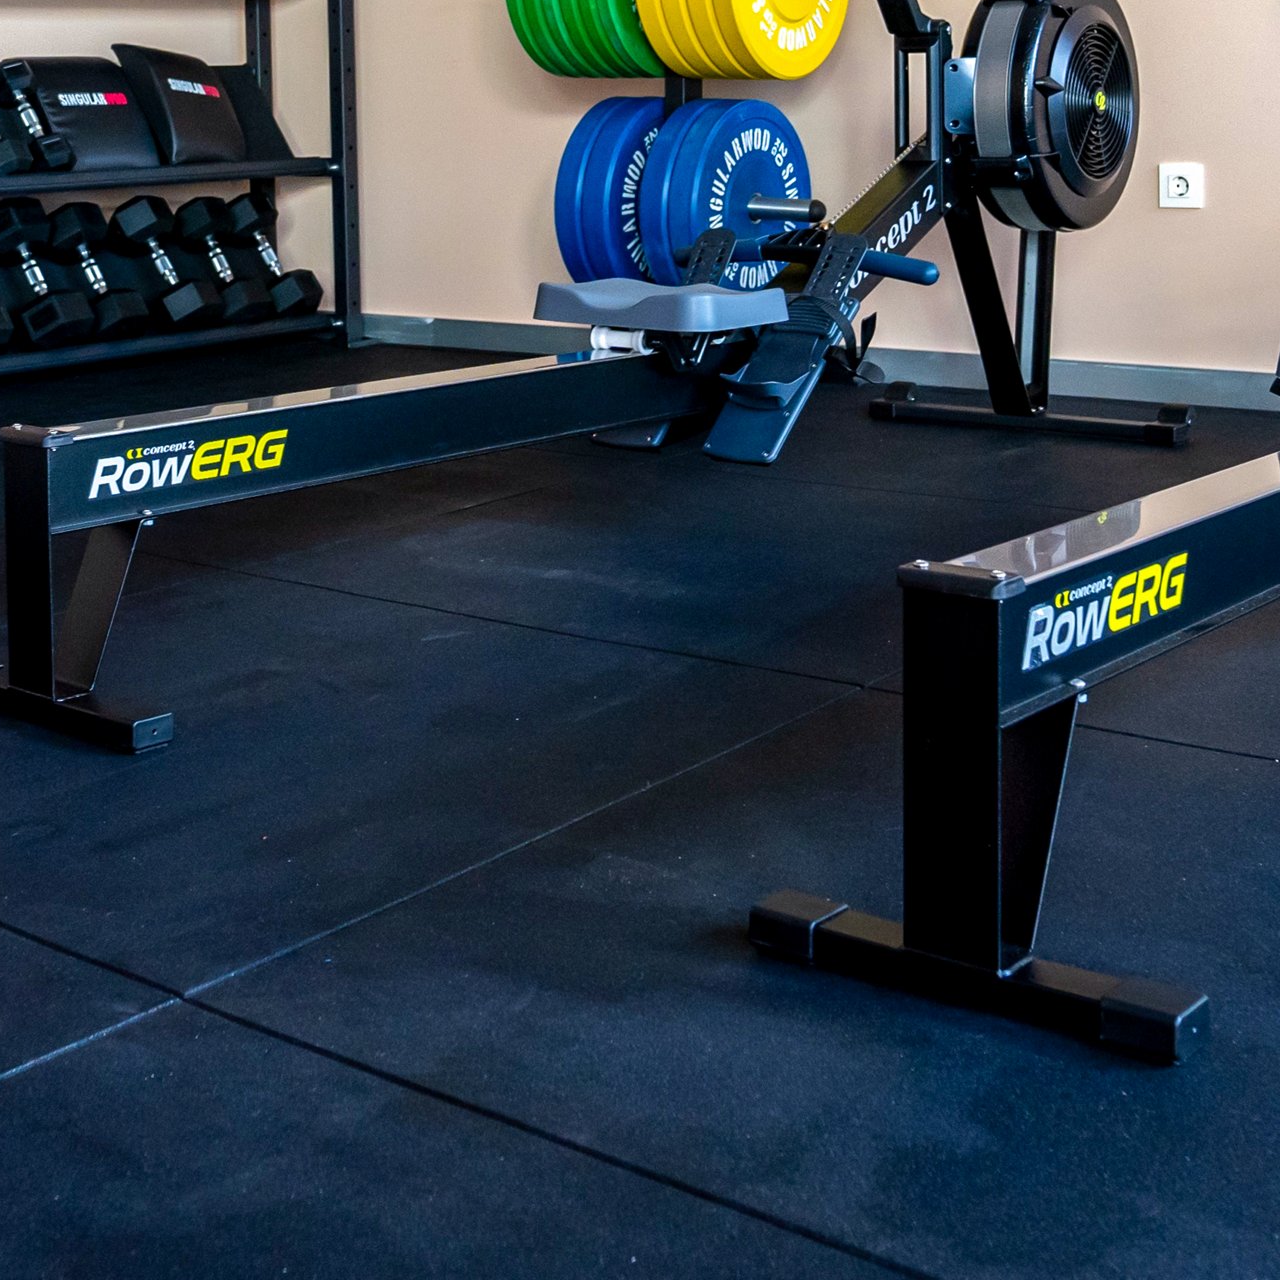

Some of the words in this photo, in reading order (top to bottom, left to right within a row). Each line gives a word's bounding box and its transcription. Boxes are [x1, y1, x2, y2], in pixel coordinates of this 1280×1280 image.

[775, 142, 788, 167] 20
[709, 128, 770, 229] NGULARWOD
[923, 184, 936, 212] 2
[142, 442, 187, 456] concept
[188, 439, 195, 450] 2
[1069, 578, 1106, 602] concept
